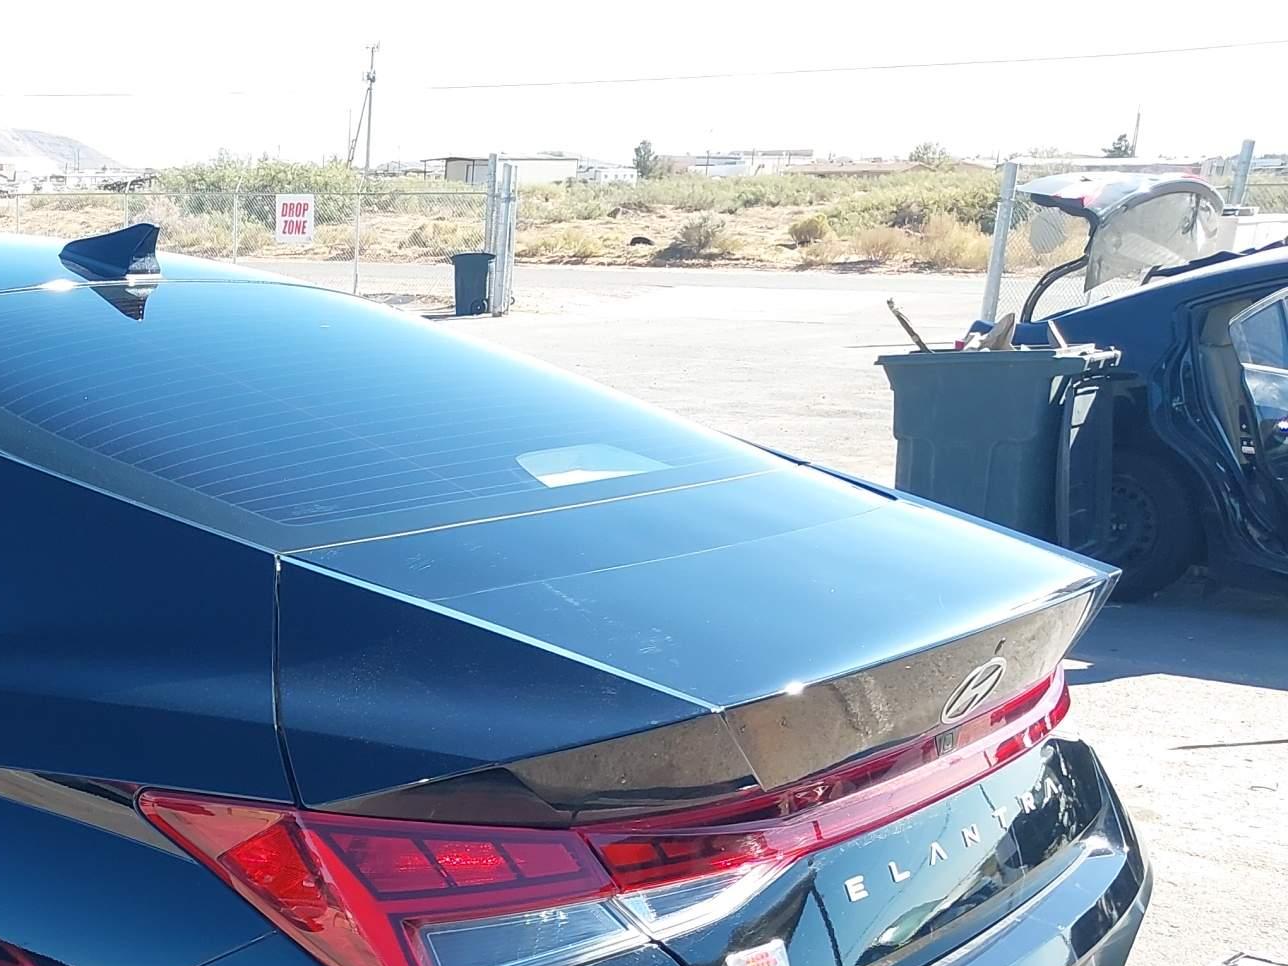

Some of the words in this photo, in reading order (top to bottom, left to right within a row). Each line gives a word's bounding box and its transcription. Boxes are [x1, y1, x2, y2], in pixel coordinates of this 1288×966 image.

[281, 202, 309, 217] DROP
[282, 220, 307, 235] ZONE
[844, 777, 1061, 902] ELANTRA
